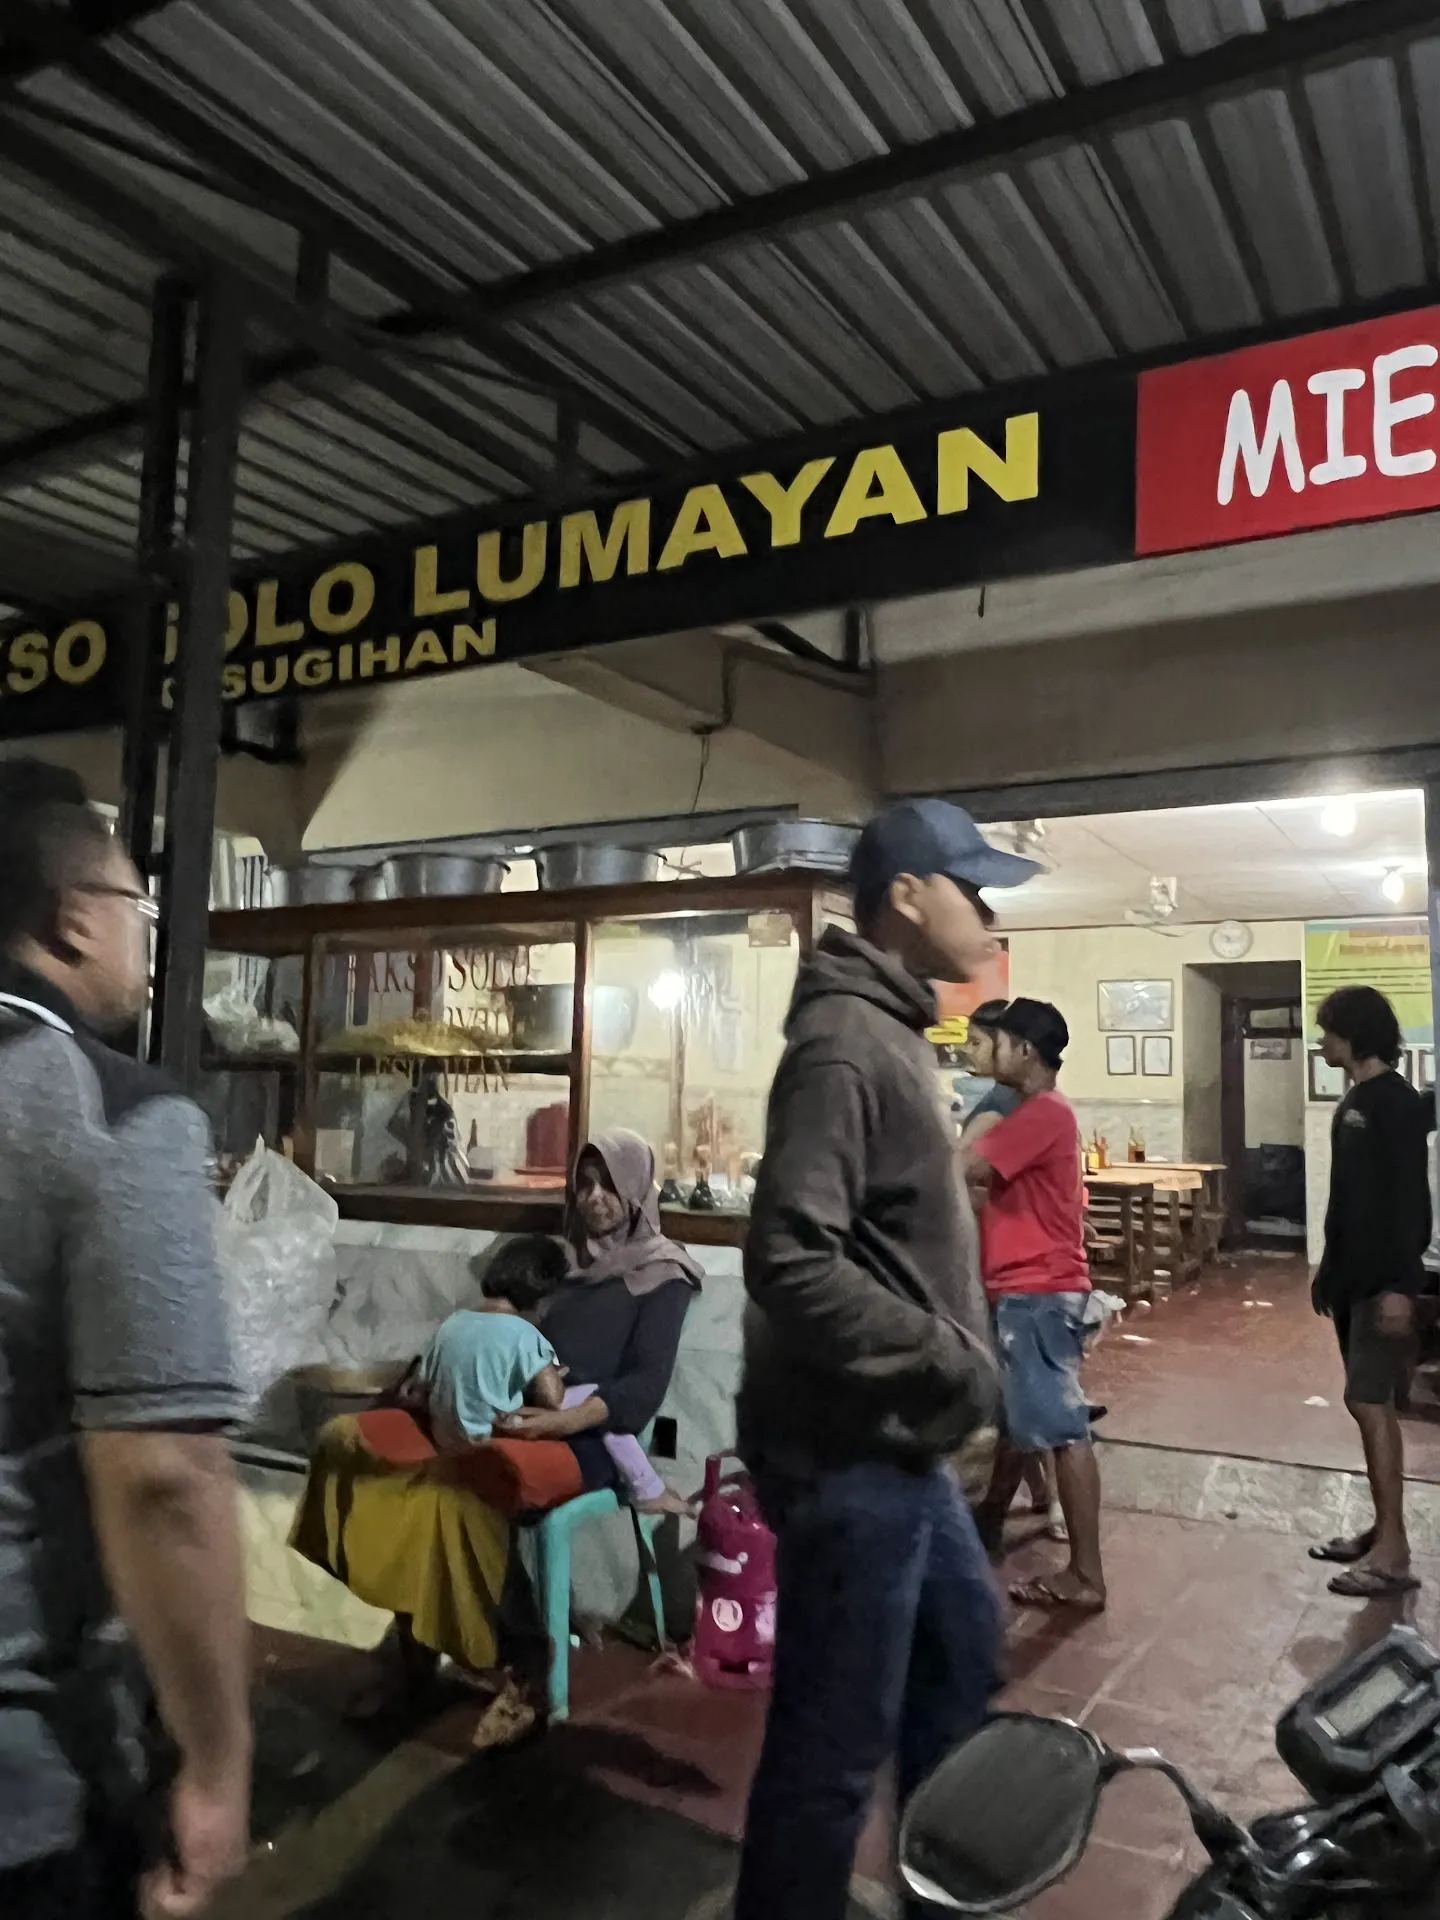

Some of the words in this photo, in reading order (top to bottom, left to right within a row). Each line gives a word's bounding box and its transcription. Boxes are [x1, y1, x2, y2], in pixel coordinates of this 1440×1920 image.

[1217, 344, 1439, 506] MIE
[0, 620, 107, 693] SO
[413, 412, 1039, 617] LUMAYAN
